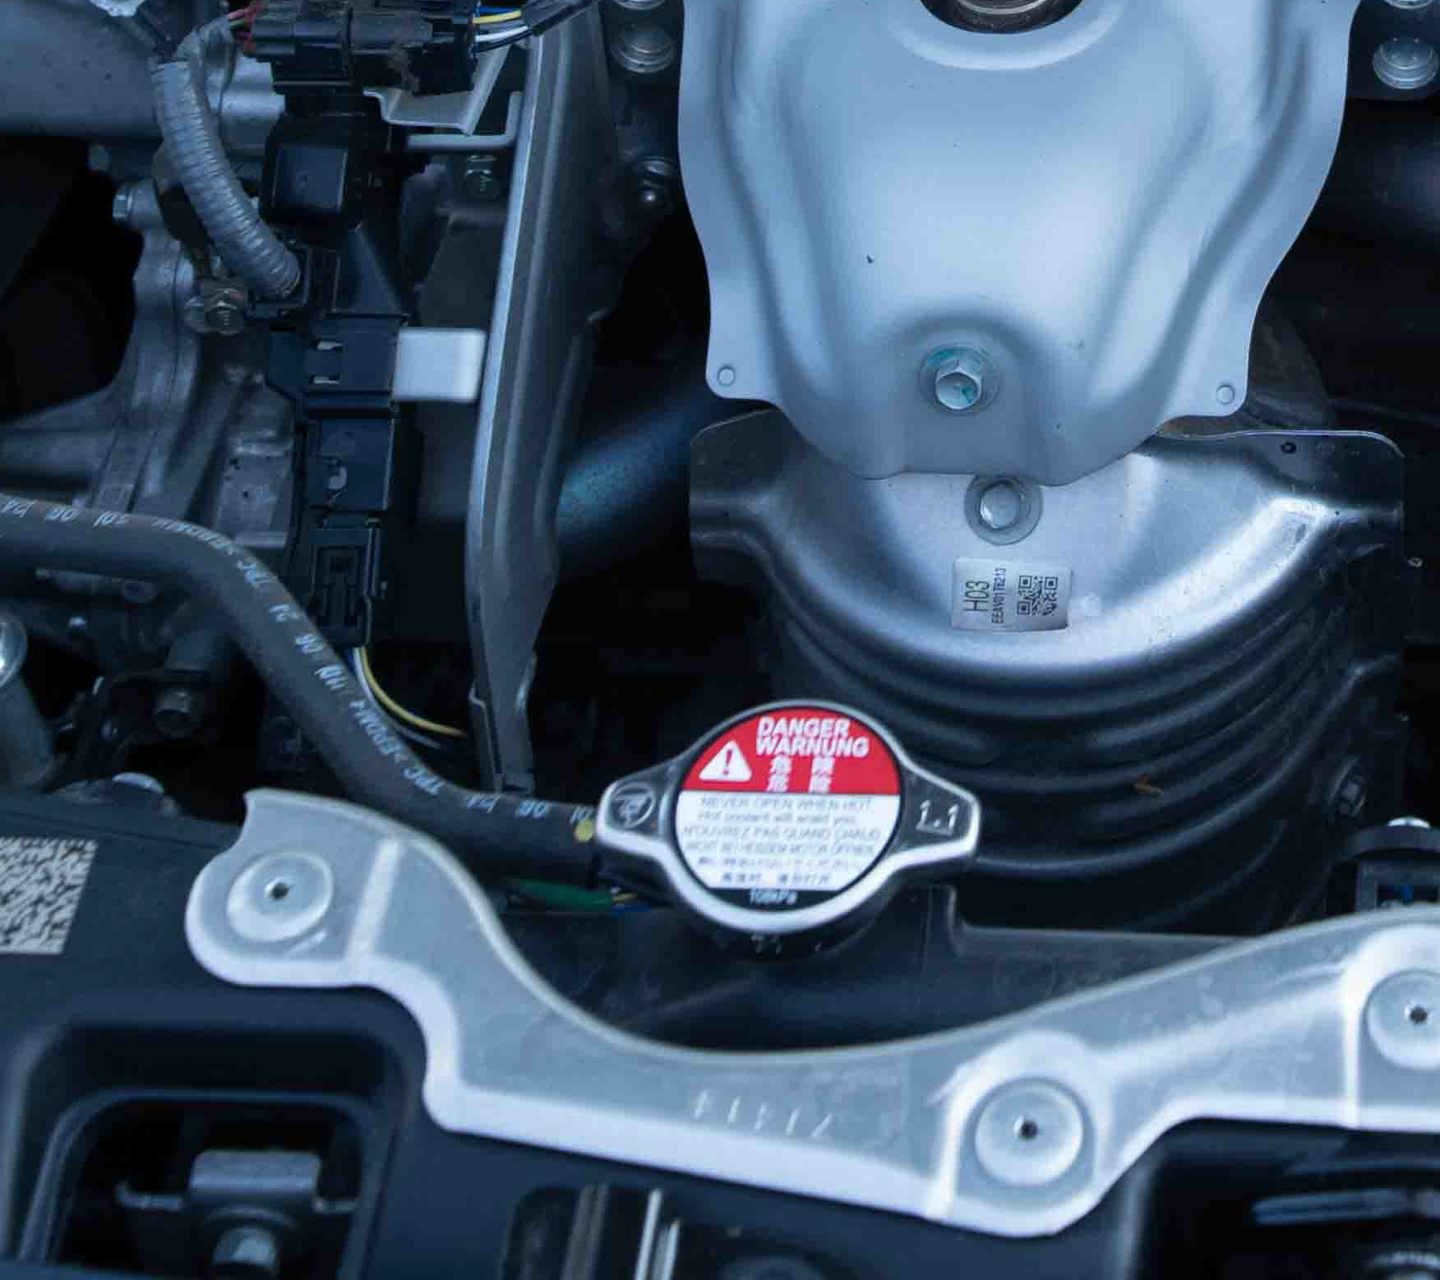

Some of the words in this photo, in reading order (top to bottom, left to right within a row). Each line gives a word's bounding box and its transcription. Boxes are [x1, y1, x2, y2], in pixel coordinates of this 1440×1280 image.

[962, 580, 990, 612] H03
[757, 716, 850, 739] DANGER
[755, 736, 869, 757] WARNUNG
